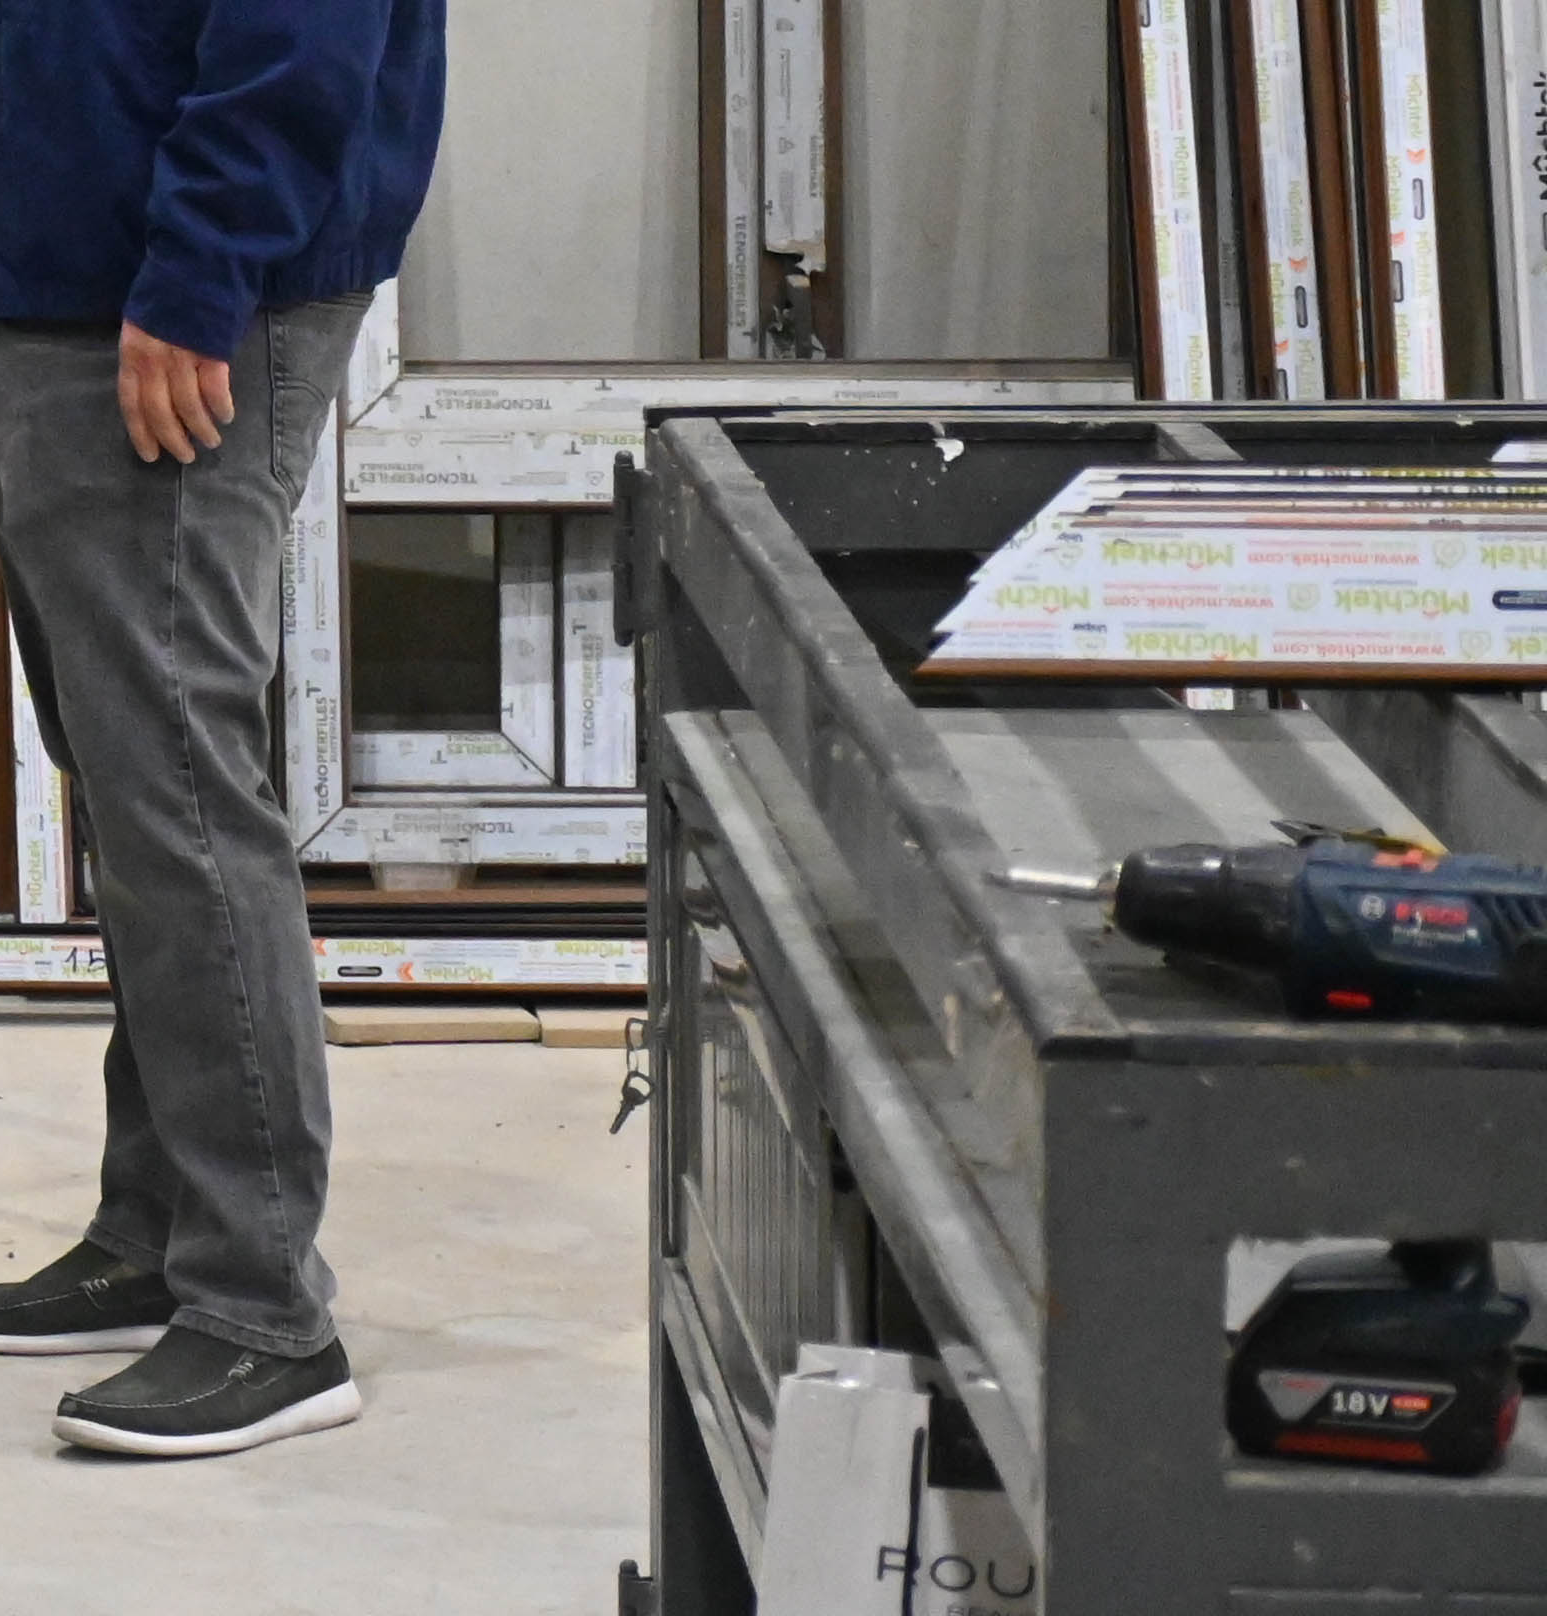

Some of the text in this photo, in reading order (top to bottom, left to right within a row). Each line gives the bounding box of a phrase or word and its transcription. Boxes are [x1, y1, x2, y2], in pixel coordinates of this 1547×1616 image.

[1248, 552, 1419, 567] www.muchtek.com
[1103, 596, 1273, 610] www.muchtek.com
[1273, 643, 1444, 658] www.muchtek.com
[1332, 1391, 1389, 1416] 18V
